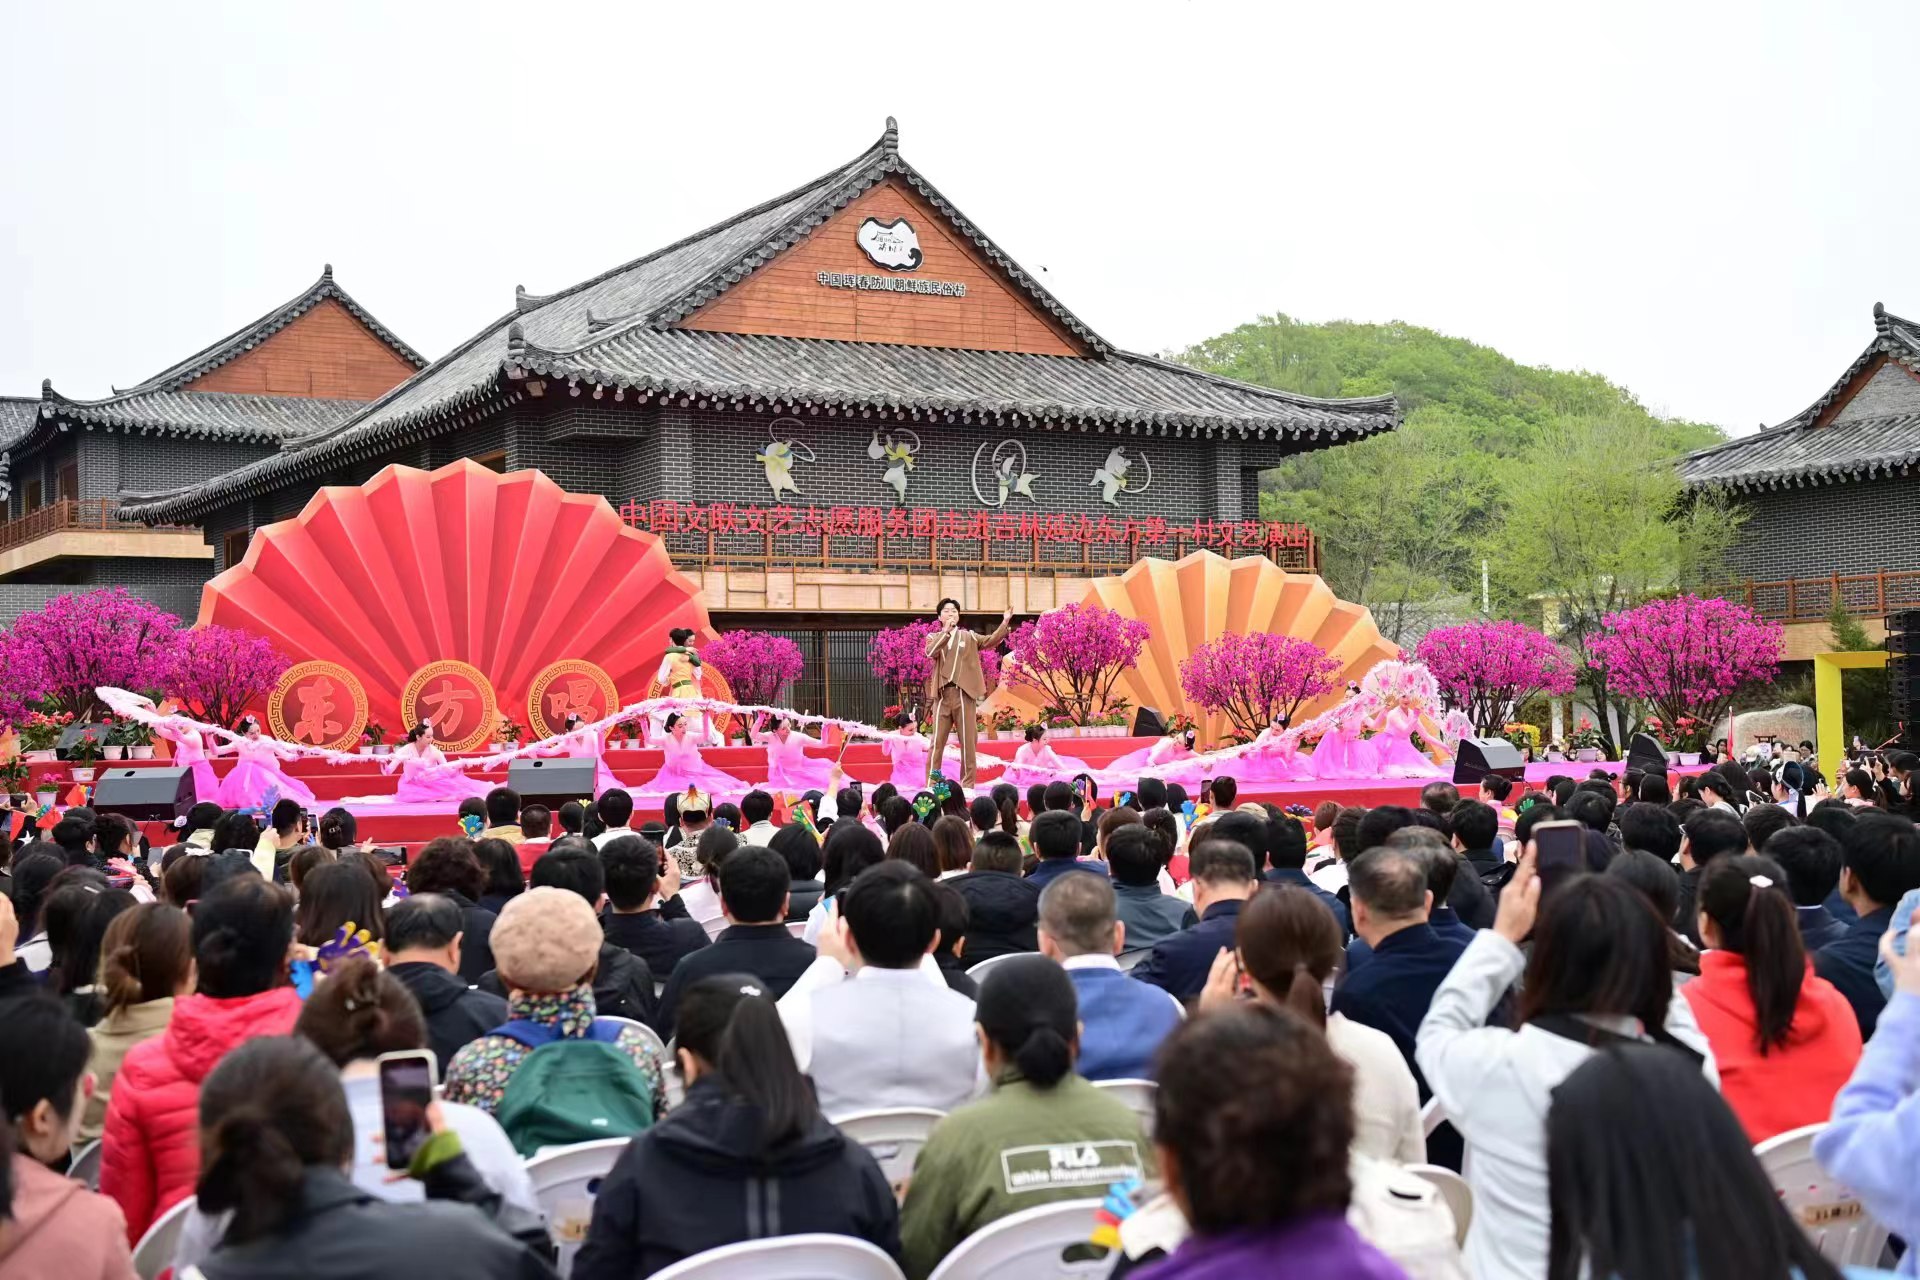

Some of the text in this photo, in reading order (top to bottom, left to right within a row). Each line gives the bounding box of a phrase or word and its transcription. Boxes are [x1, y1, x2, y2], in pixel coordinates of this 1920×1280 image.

[817, 271, 966, 296] 中国珲春防川朝鲜族民俗村
[619, 498, 1309, 548] 中国文联文艺志愿服务团走进吉林延边东方第一村文艺演出
